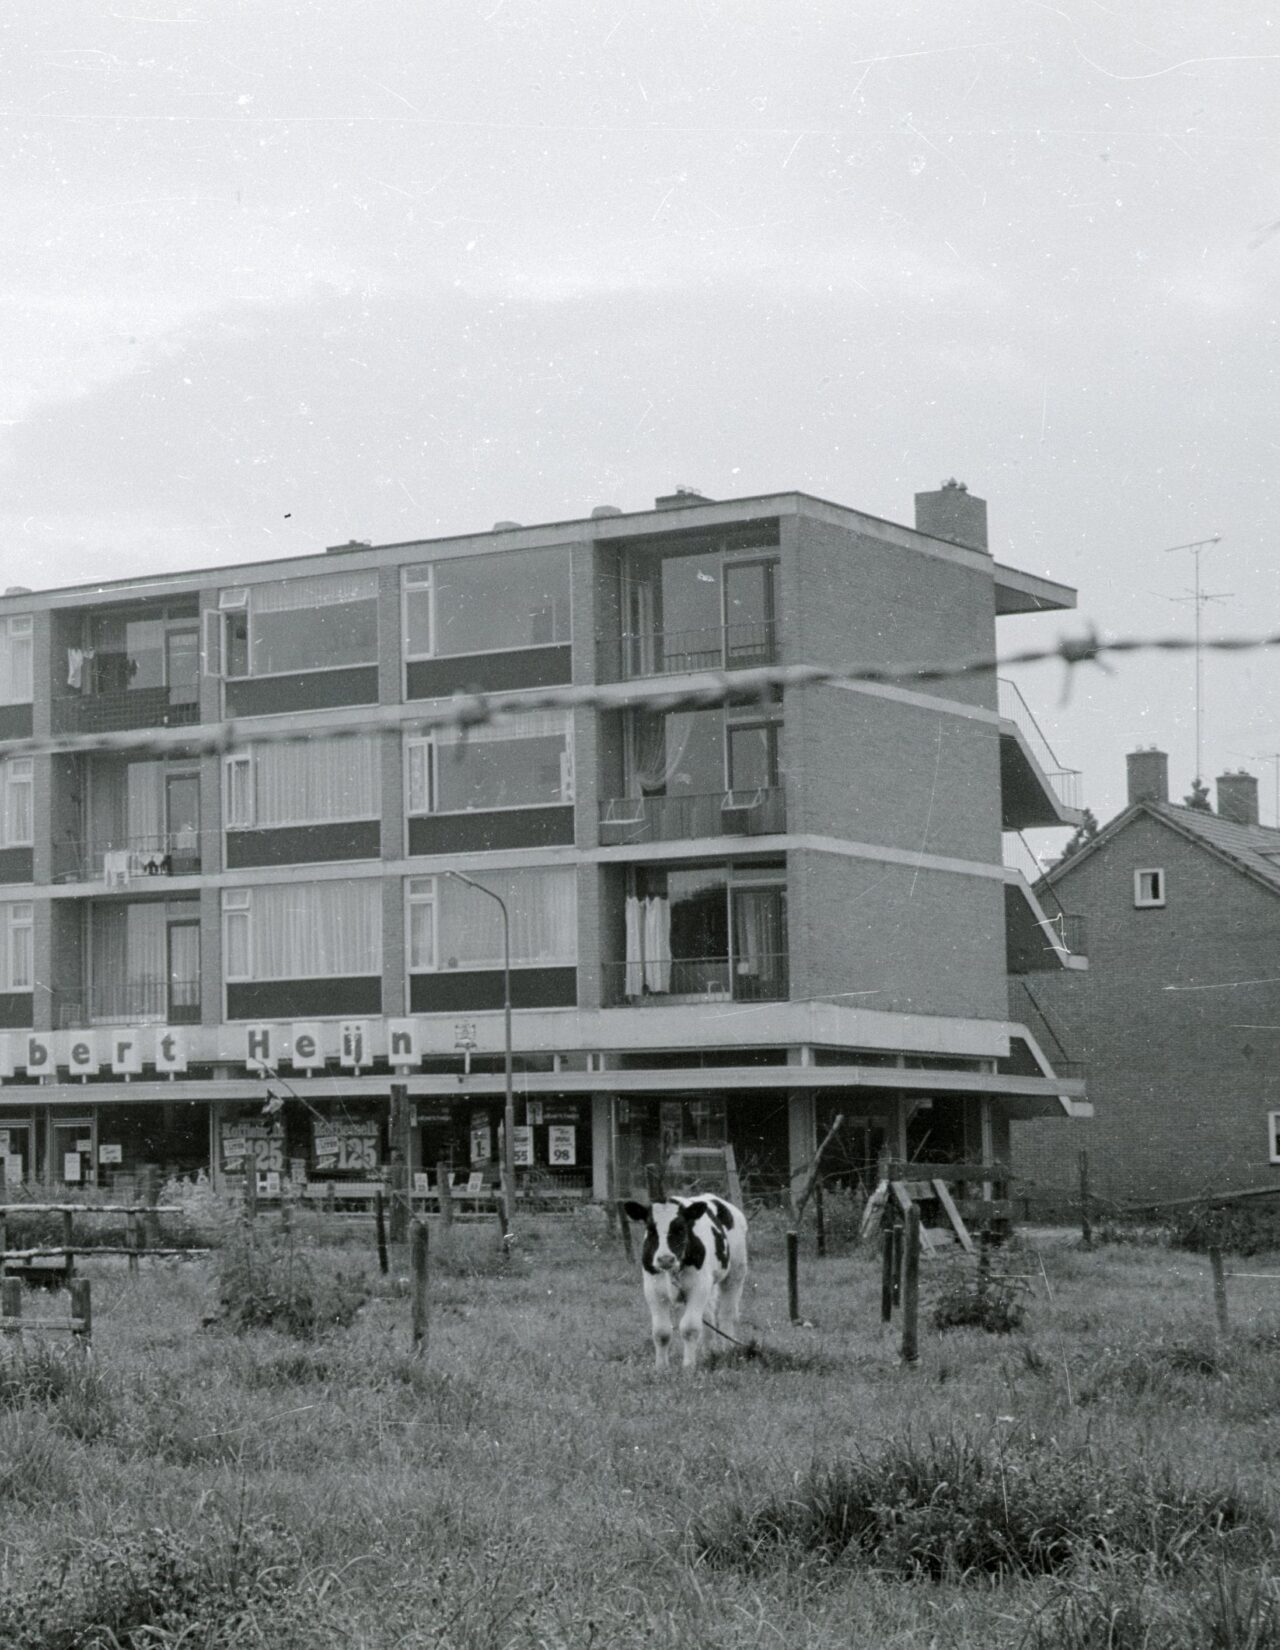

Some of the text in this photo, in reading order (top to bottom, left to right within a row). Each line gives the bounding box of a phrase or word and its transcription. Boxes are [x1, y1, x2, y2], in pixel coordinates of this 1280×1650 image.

[248, 1025, 411, 1064] Heijn
[338, 1138, 377, 1169] 125
[553, 1149, 570, 1161] 98
